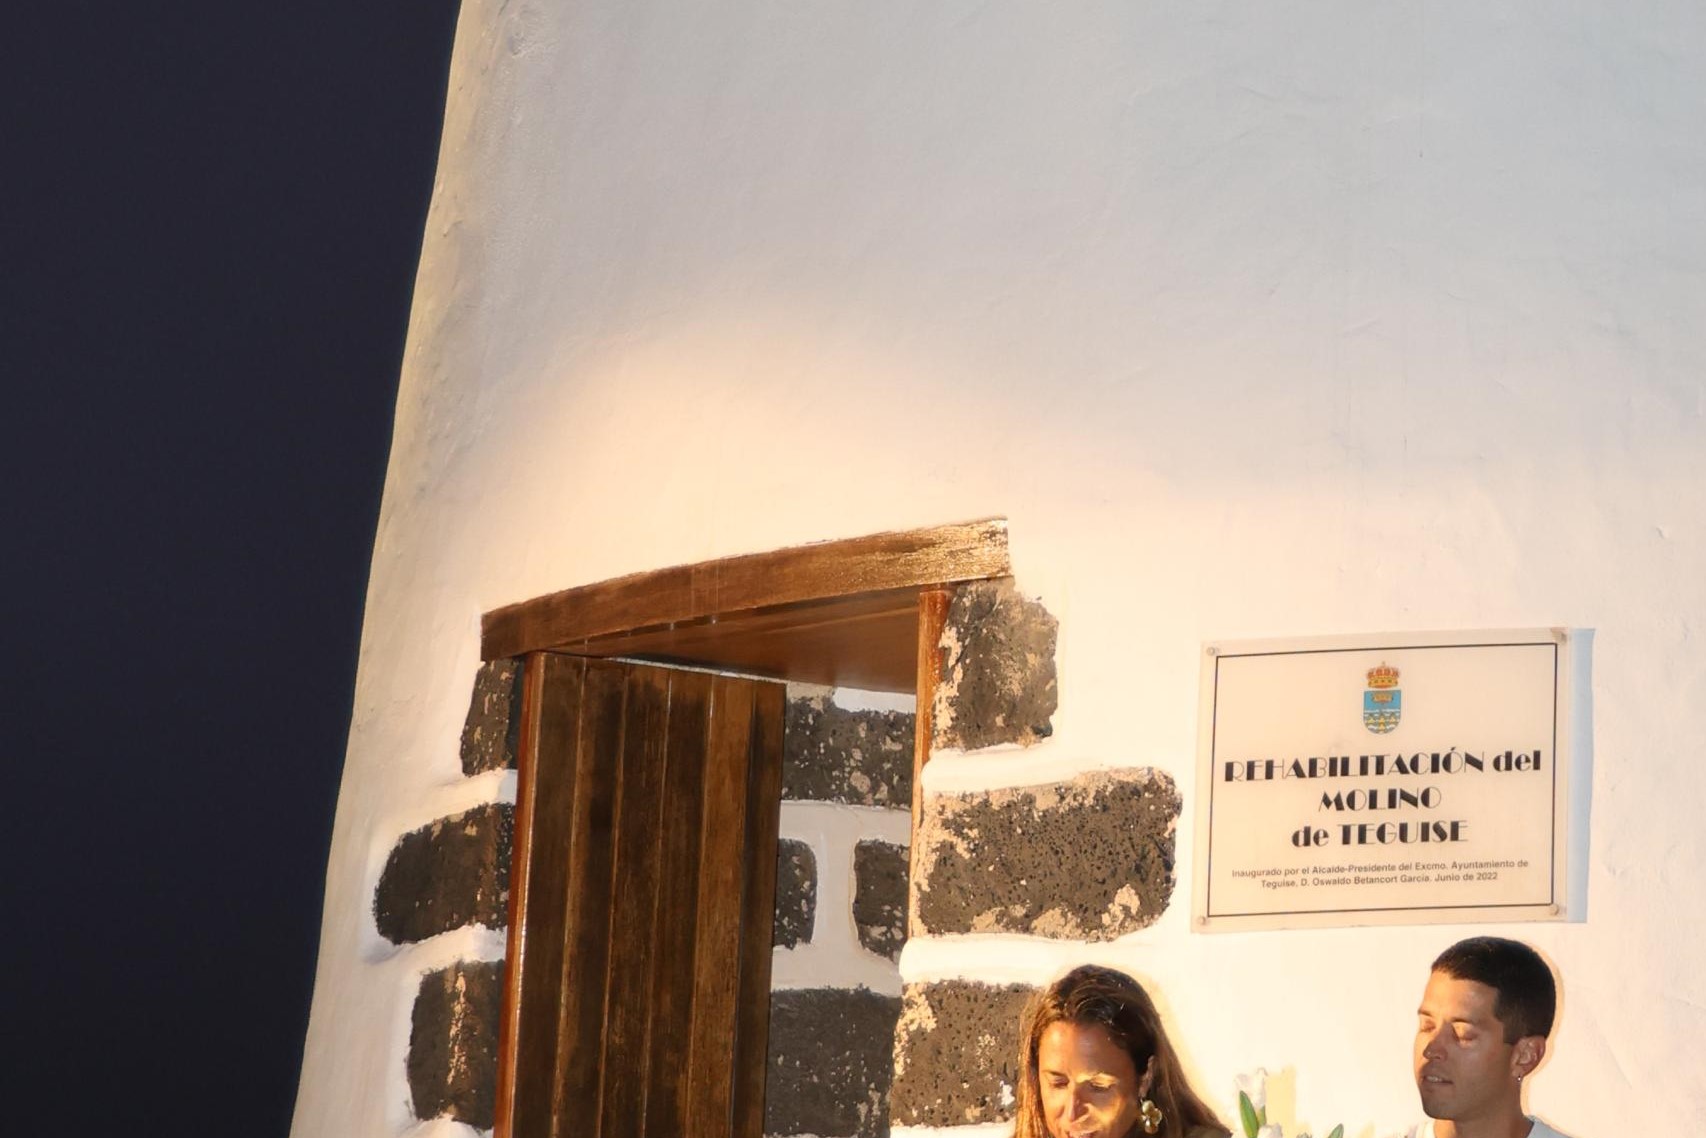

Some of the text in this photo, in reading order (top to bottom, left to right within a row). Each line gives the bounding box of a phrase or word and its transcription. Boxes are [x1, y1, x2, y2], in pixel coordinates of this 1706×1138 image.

[1224, 746, 1541, 782] REHABILITACIÓN del
[1318, 786, 1442, 812] MOLINO
[1292, 820, 1468, 847] de TEGUISE
[1232, 859, 1528, 879] Inaugurado por el Alcalde-Presidente del Excmo. Ayuntamiento de
[1300, 879, 1310, 887] D.
[1312, 876, 1352, 886] Oswaldo
[1354, 874, 1398, 885] Betancort
[1434, 872, 1461, 882] Junio
[1463, 872, 1474, 881] de
[1476, 872, 1498, 881] 2022
